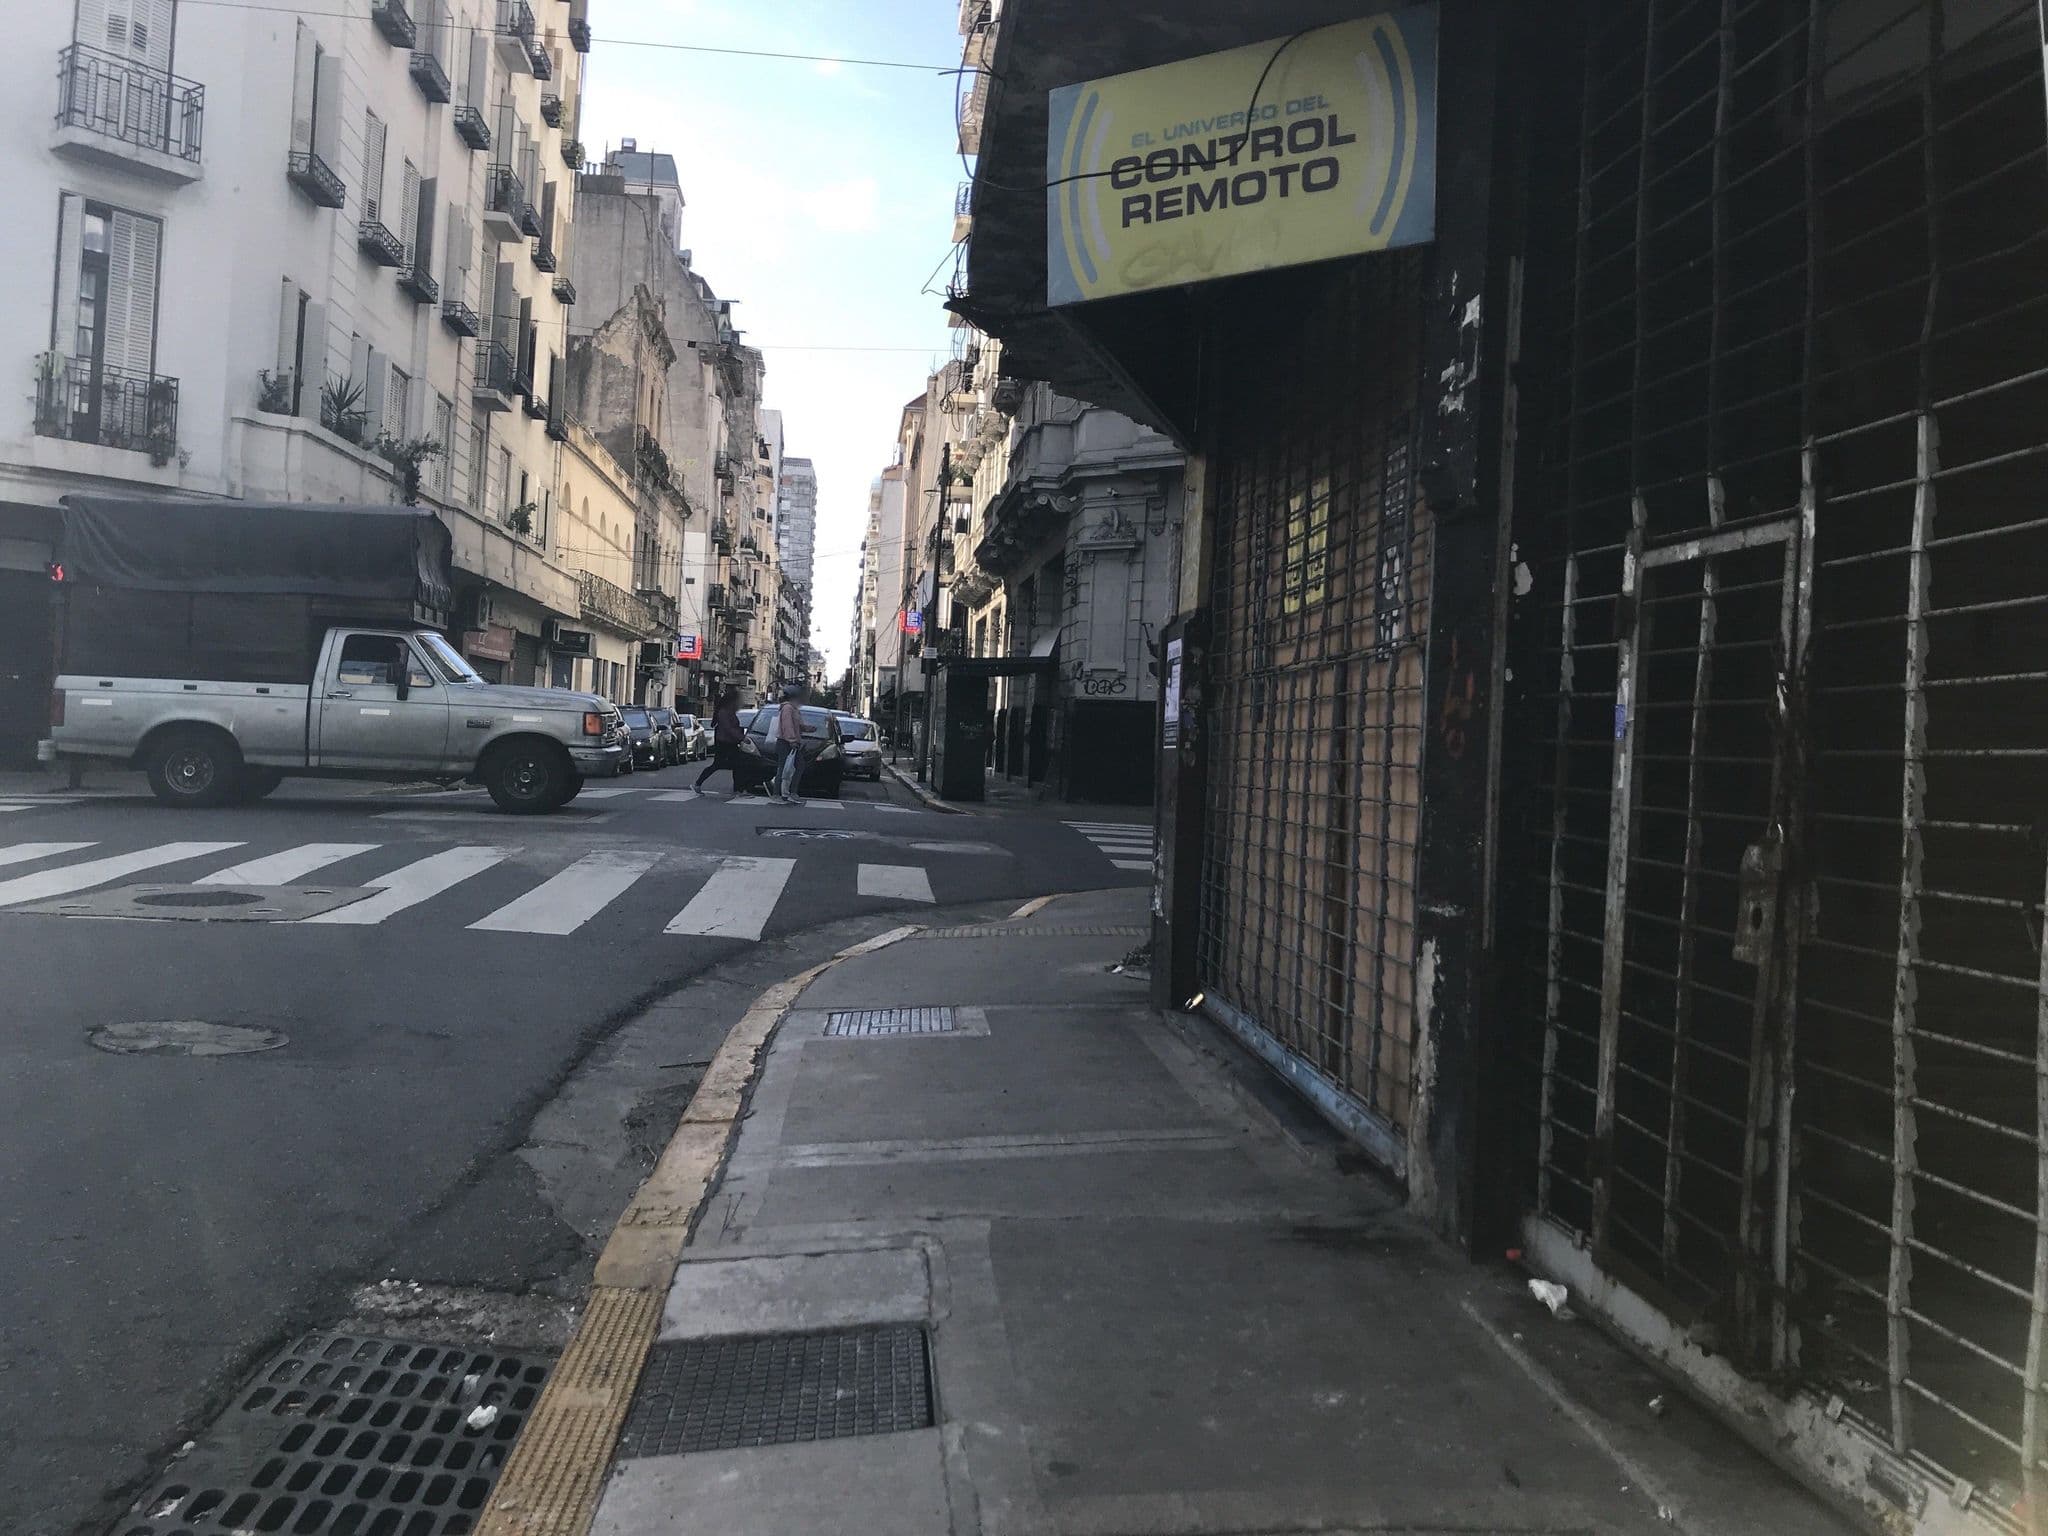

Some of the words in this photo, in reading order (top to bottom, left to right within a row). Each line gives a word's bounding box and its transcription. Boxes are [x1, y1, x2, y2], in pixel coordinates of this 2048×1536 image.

[1111, 114, 1356, 190] CONTROL
[1131, 131, 1155, 149] EL
[1163, 103, 1278, 141] UNIVERSO
[1286, 95, 1329, 116] DEL
[1122, 157, 1339, 228] REMOTO
[680, 636, 694, 652] E
